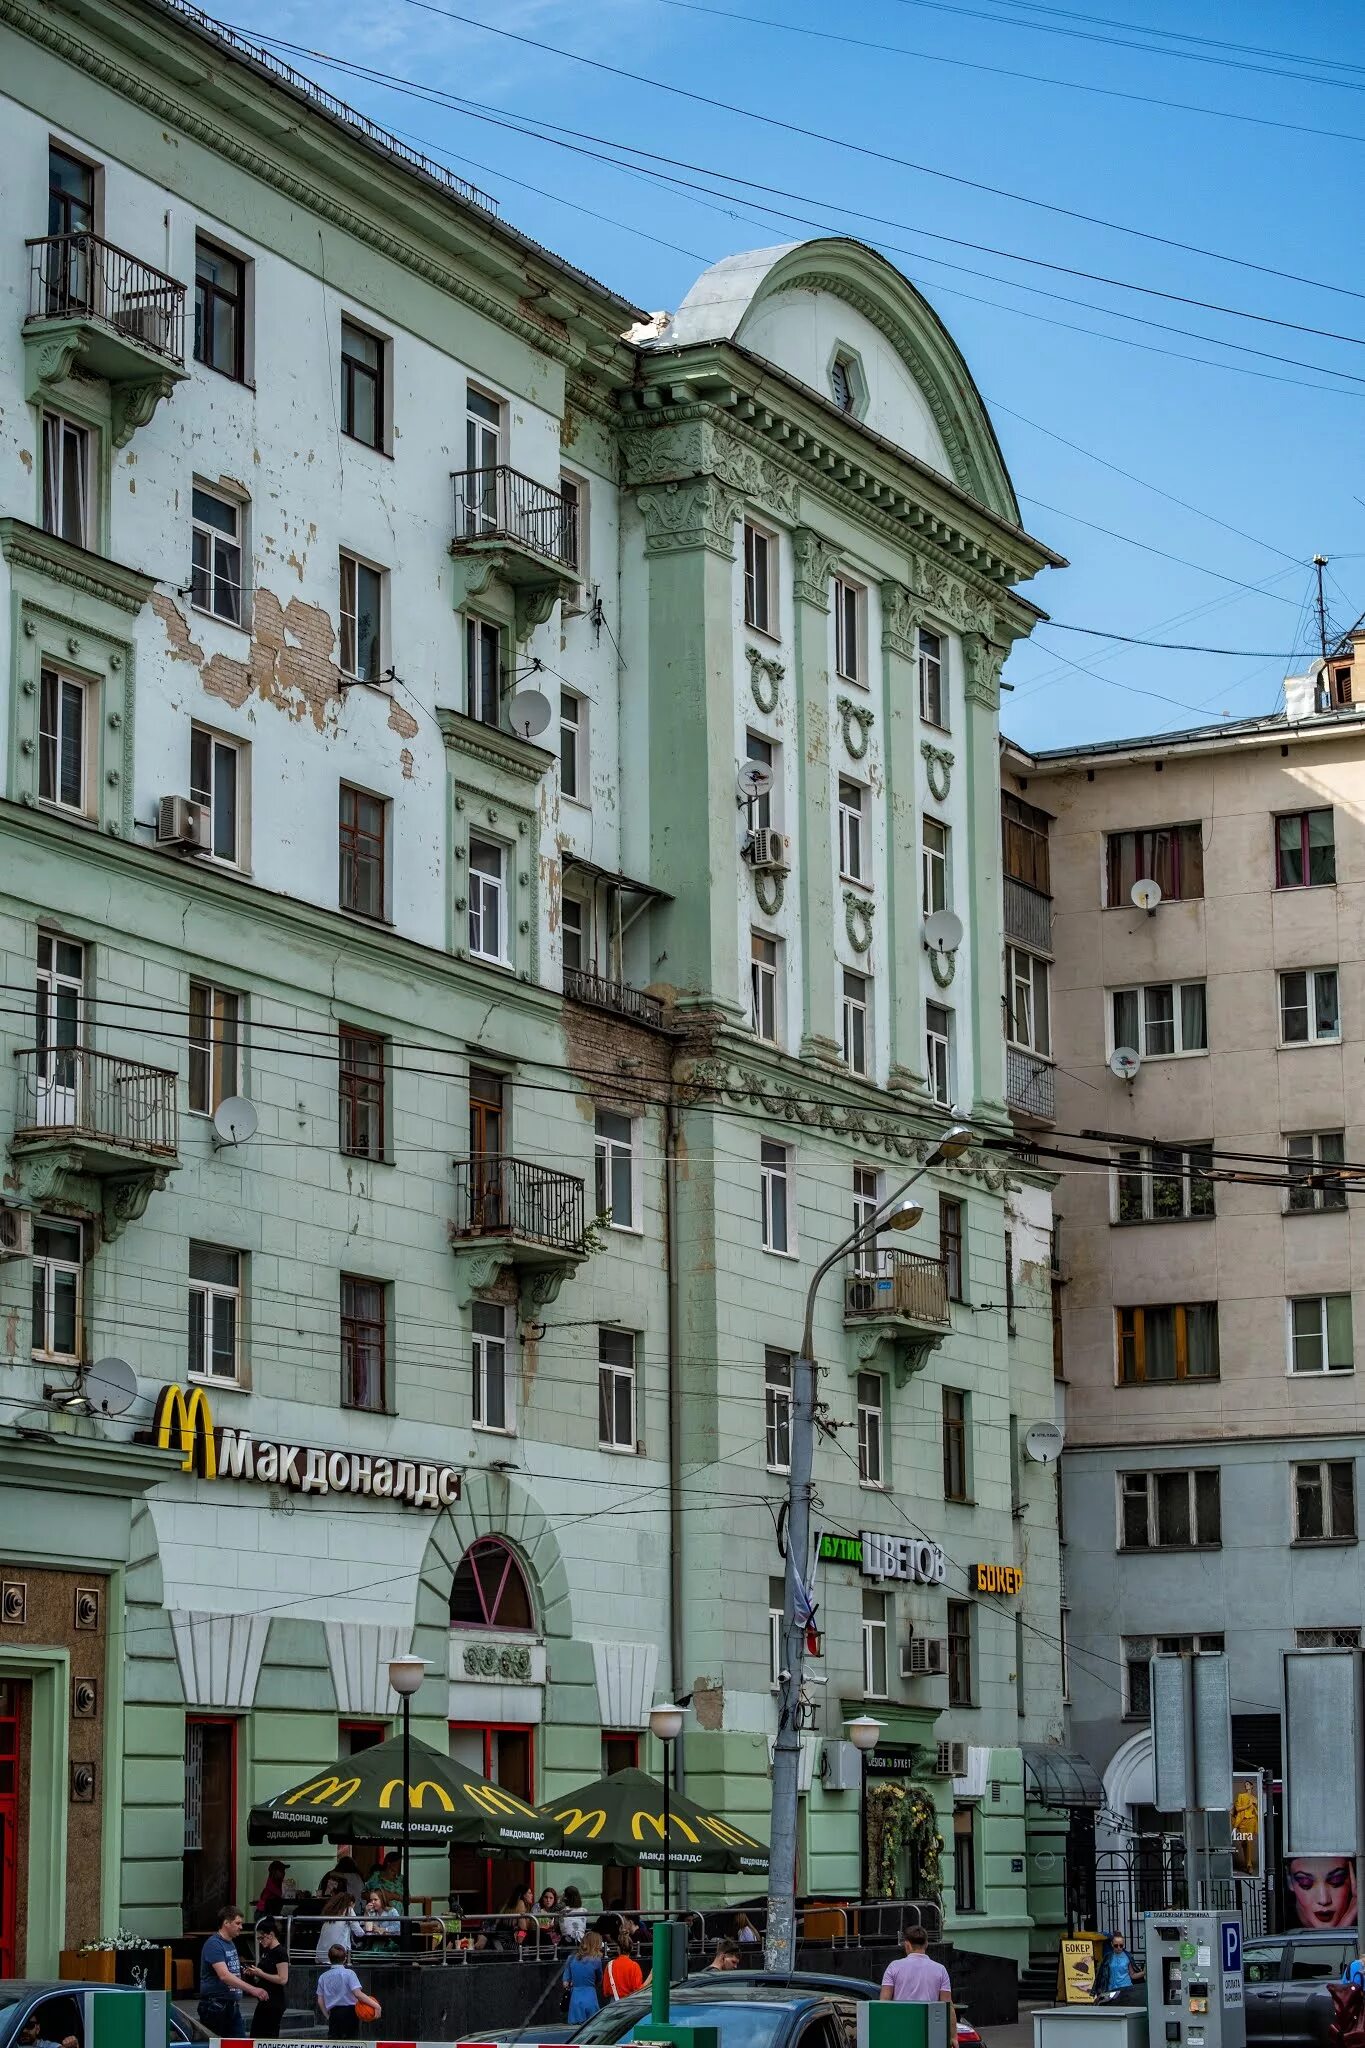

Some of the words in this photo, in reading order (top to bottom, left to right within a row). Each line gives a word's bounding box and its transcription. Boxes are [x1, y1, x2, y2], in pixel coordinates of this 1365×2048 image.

[218, 1427, 460, 1508] Макдоналдс
[822, 1536, 863, 1562] БУТИК
[862, 1531, 946, 1583] ЦВЕТОВ
[977, 1564, 1024, 1594] БОКЕР
[272, 1810, 328, 1825] Макдоналдс
[499, 1828, 545, 1841] Макдоналдс
[639, 1851, 703, 1863] Макдналдс
[1065, 1944, 1090, 1953] БОКЕР
